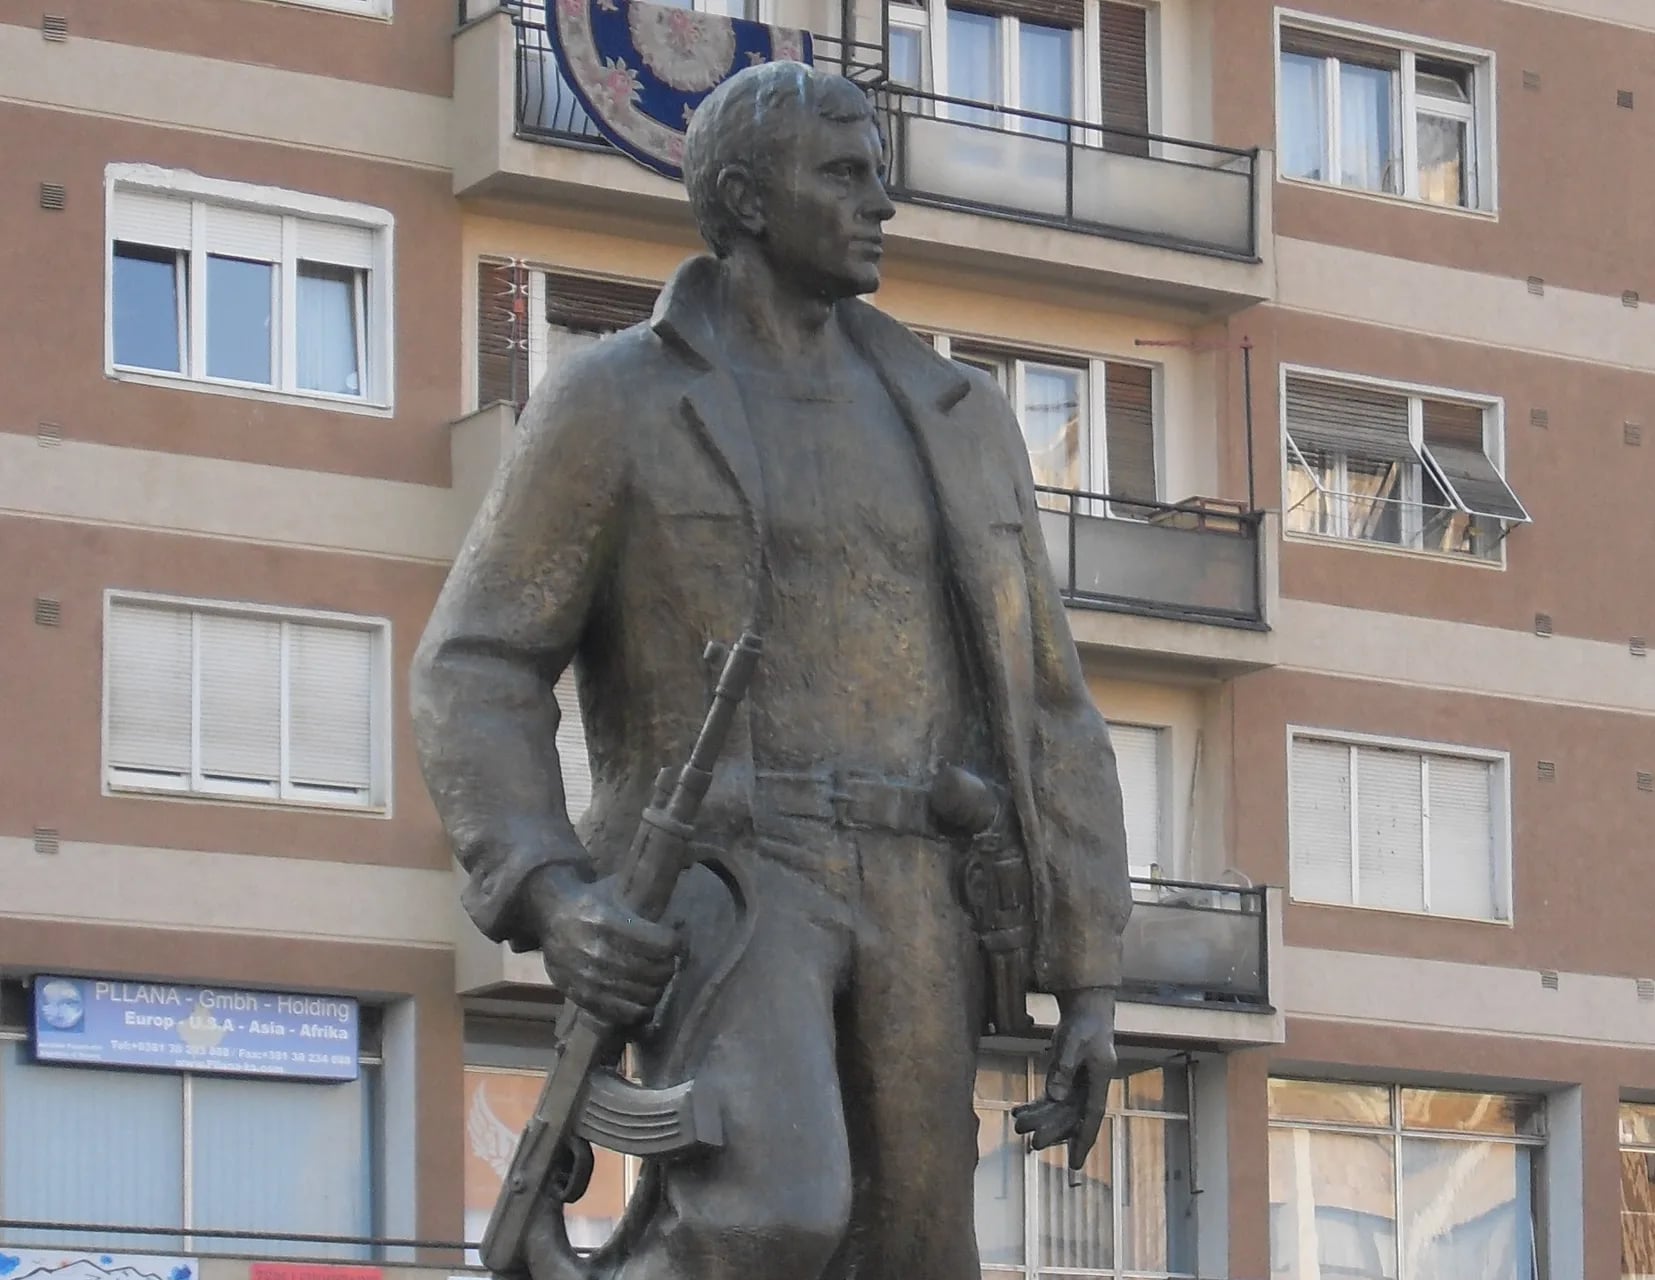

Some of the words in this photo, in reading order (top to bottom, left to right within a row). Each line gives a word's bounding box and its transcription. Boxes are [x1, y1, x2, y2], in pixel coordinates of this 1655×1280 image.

[95, 982, 180, 1006] PLLANA
[200, 990, 258, 1011] Gmbh
[278, 1000, 349, 1020] Holding
[125, 1011, 174, 1029] Europ
[249, 1021, 284, 1036] Asia
[300, 1025, 348, 1040] Afrika
